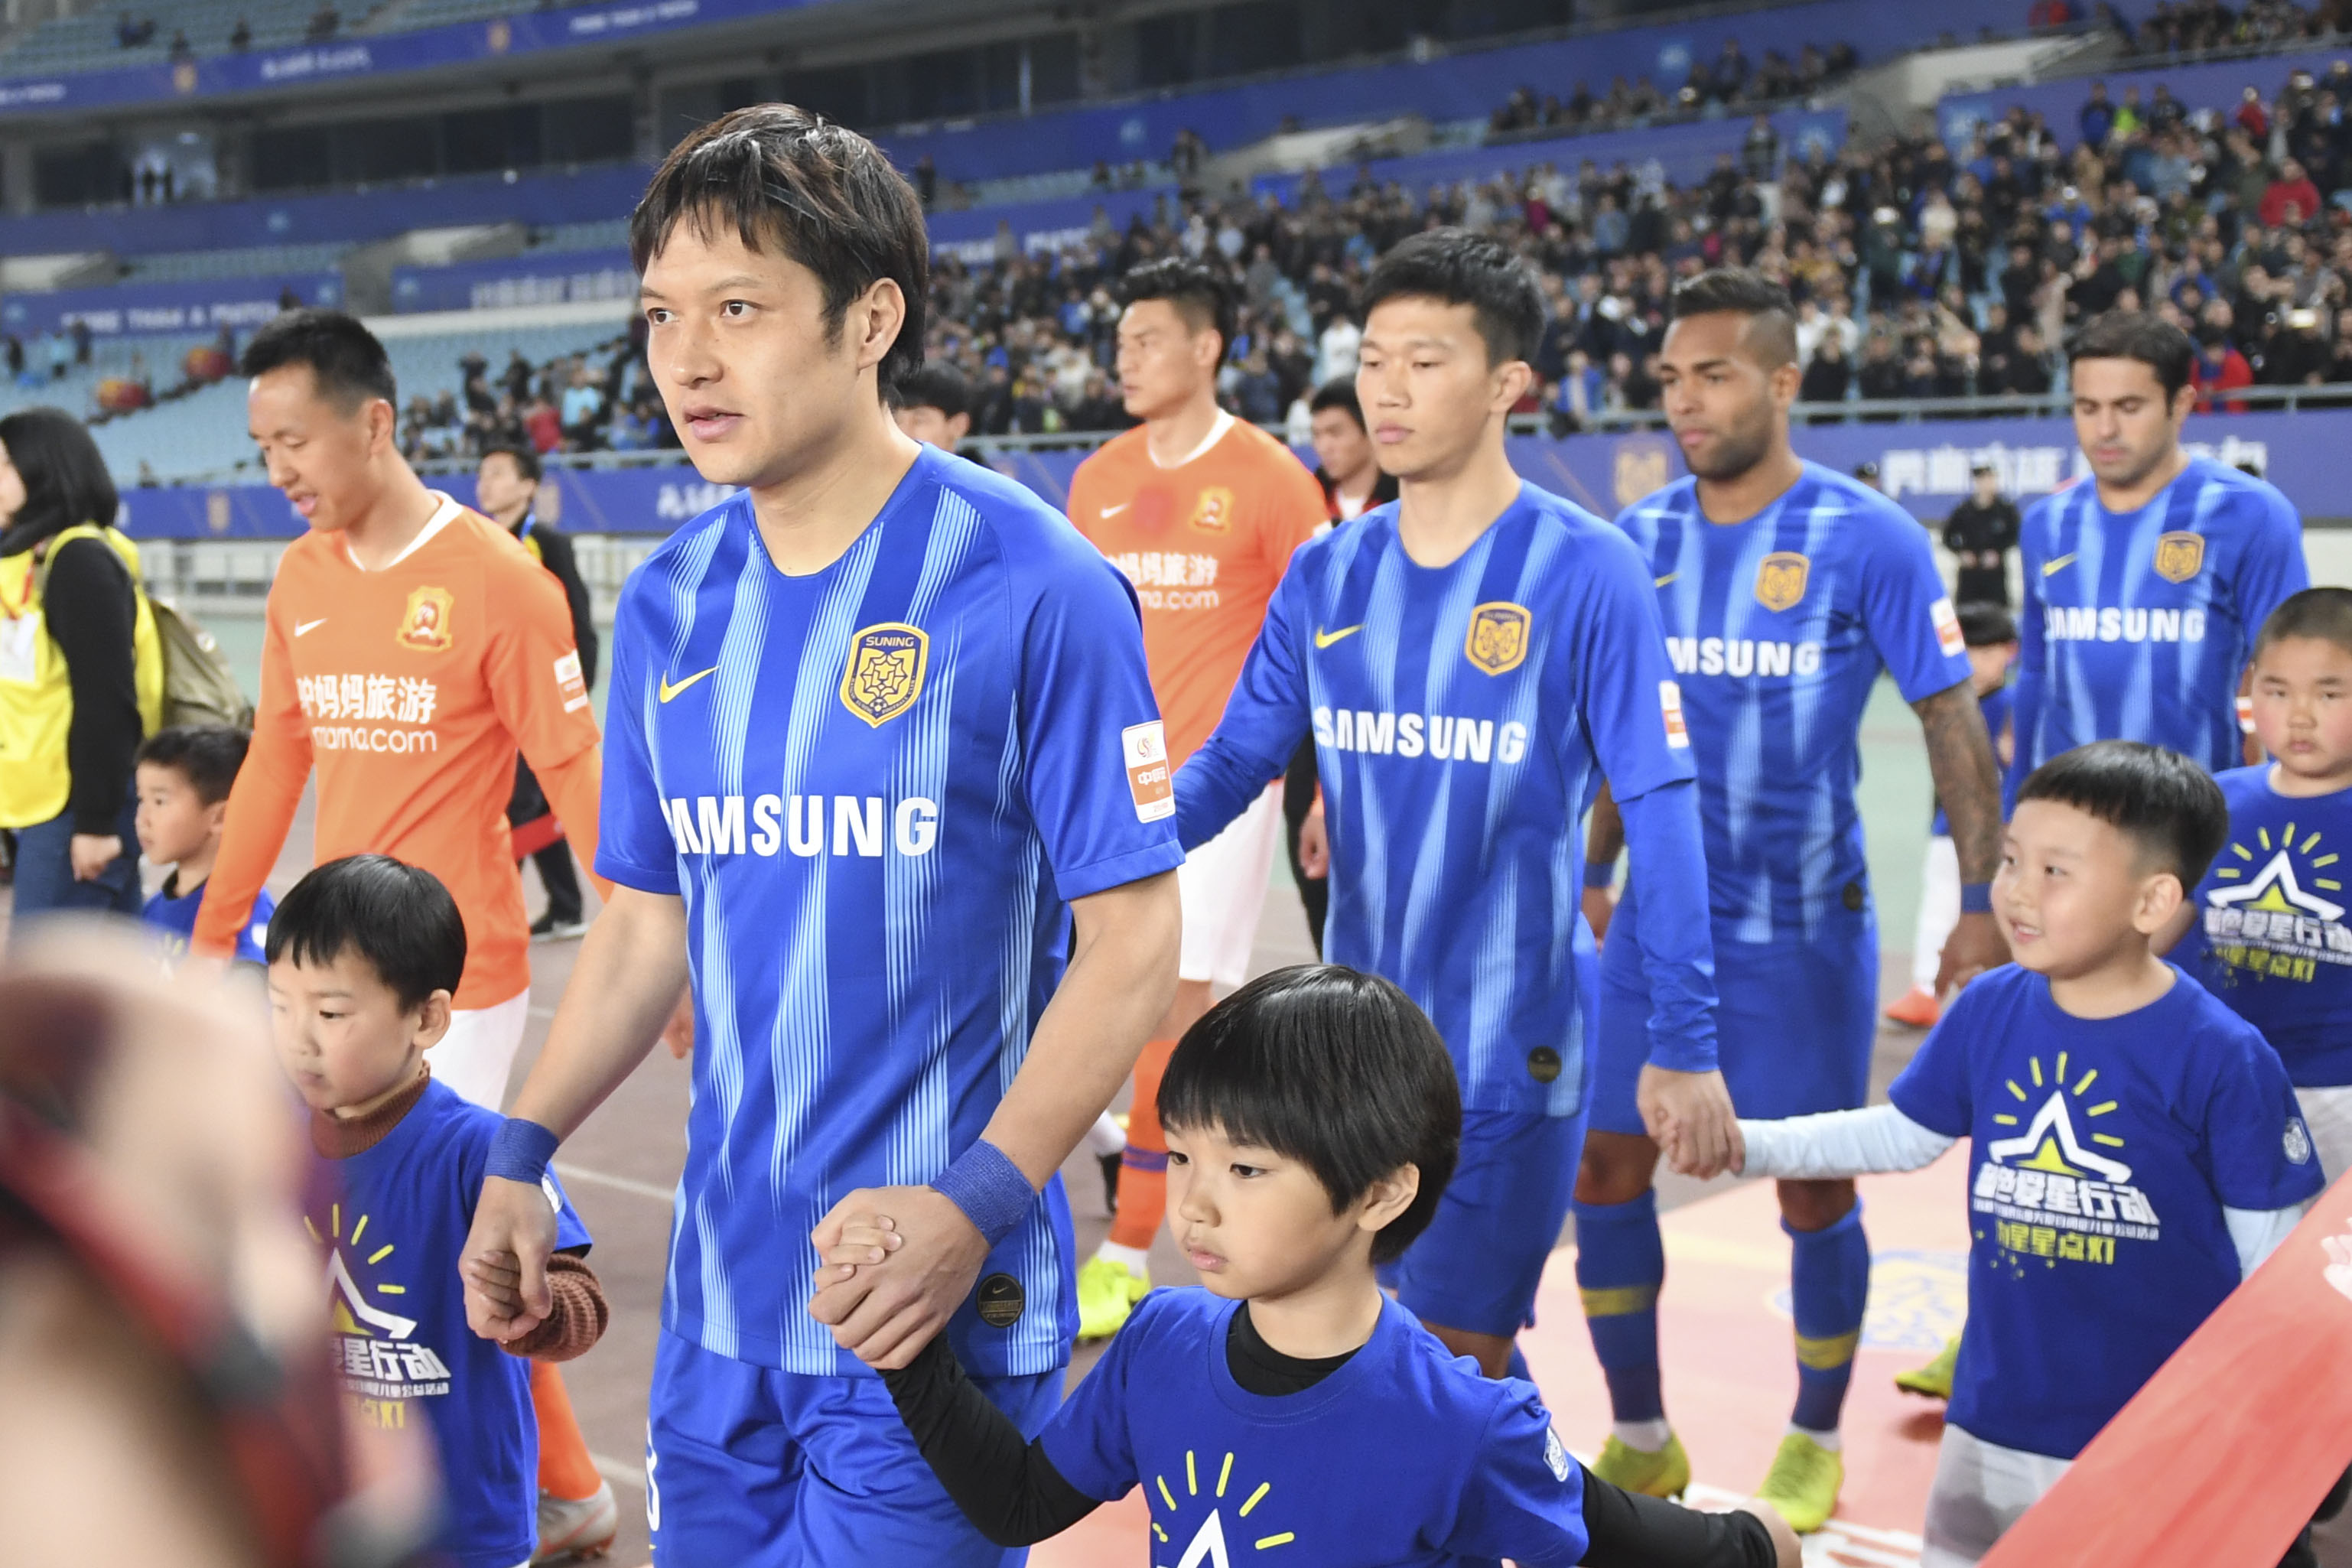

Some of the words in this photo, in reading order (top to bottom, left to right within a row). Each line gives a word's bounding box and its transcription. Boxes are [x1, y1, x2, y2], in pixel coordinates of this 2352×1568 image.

[865, 636, 915, 647] SUNING
[2045, 606, 2205, 642] AMSUNG
[1665, 636, 1821, 677] MSUNG
[1313, 705, 1527, 765] SAMSUNG
[659, 793, 938, 857] AMSUNG
